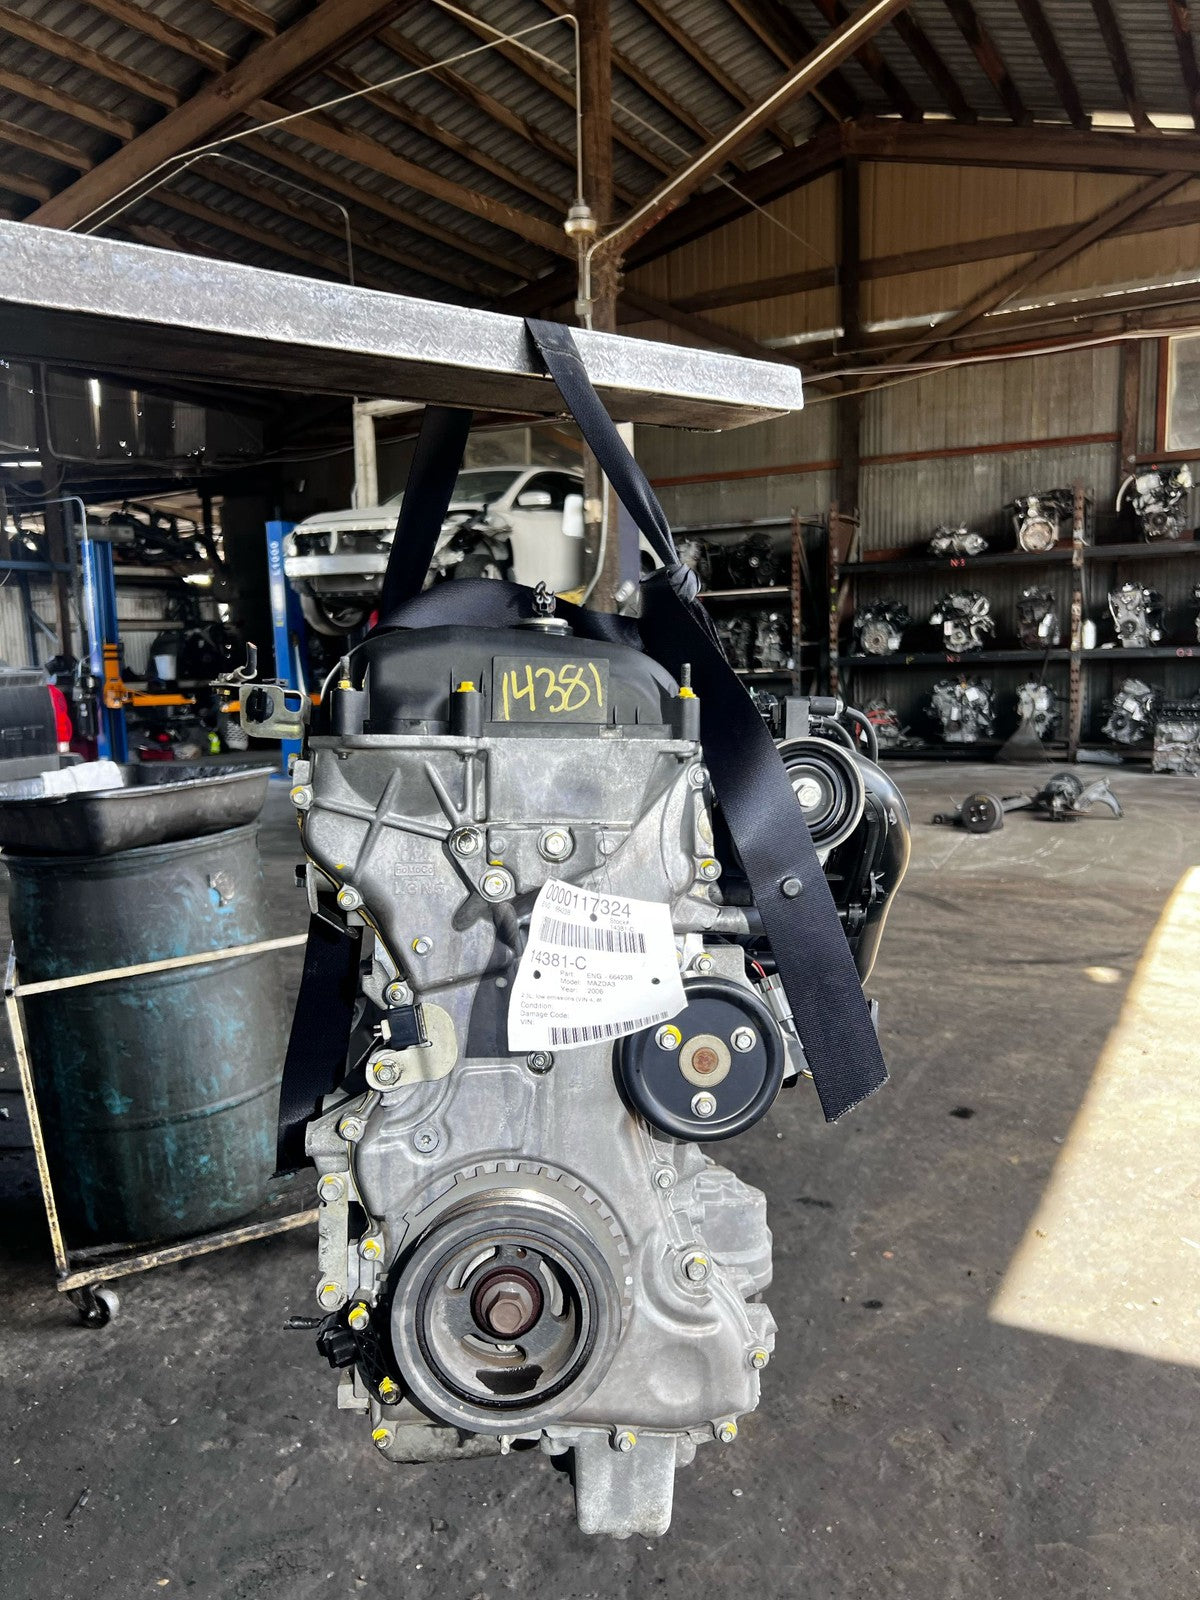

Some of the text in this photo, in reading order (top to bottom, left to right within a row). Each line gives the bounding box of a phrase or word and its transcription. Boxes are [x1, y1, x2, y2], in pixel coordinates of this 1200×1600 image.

[502, 662, 603, 721] 14381
[546, 884, 631, 918] 0000117324
[531, 949, 587, 970] 14381-C
